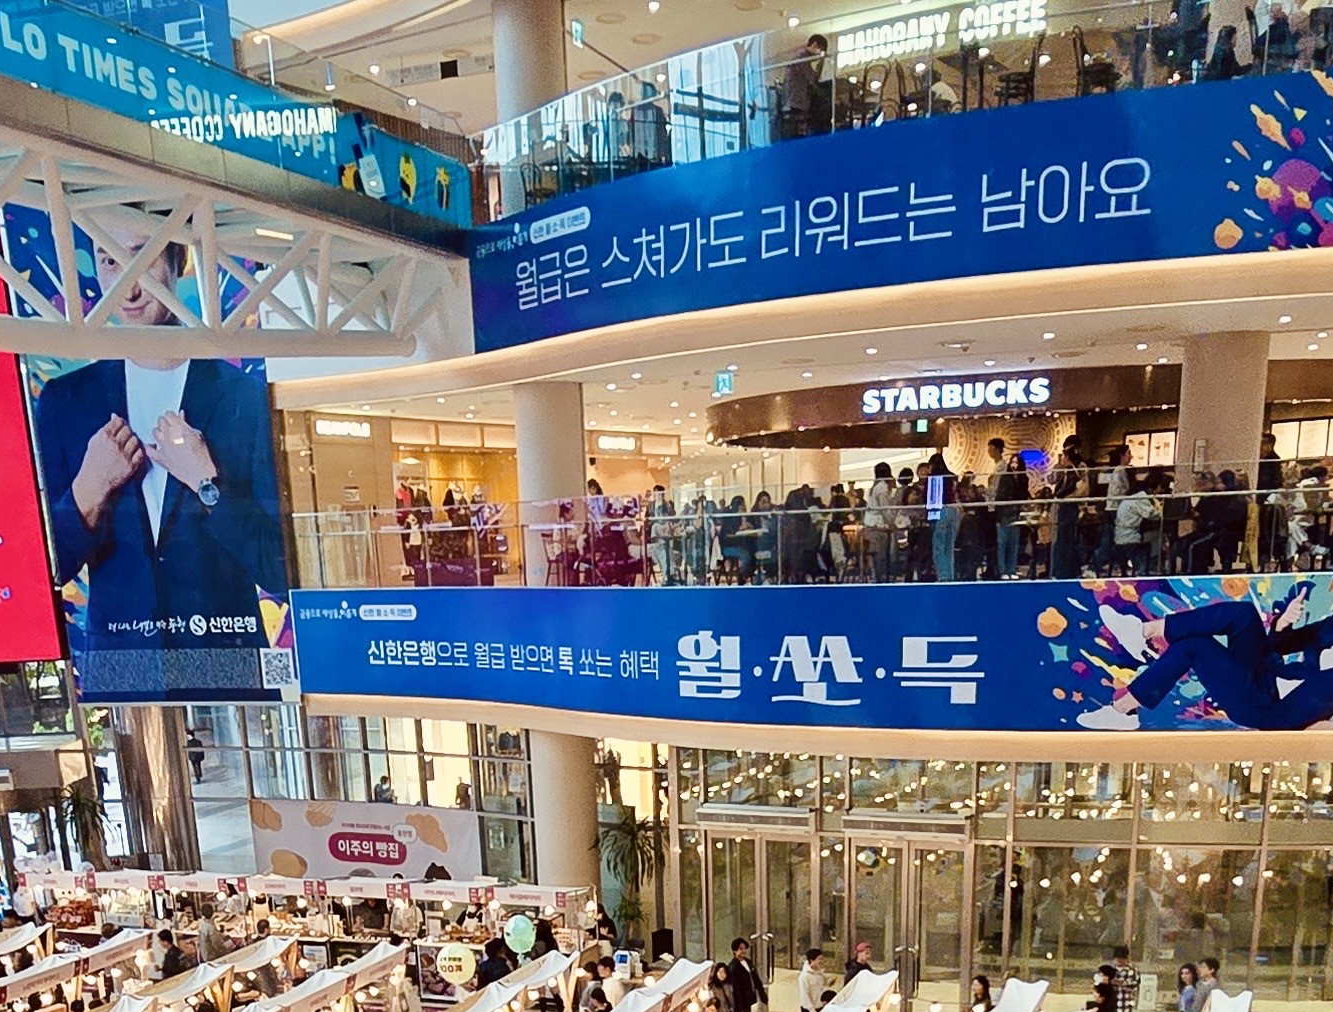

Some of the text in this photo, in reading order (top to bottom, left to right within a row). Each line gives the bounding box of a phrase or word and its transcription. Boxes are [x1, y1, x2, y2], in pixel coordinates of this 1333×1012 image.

[57, 33, 157, 100] TIMES
[515, 155, 1152, 311] 월급은 스쳐가도 리워드는 남아요
[862, 377, 1050, 414] STARBUCKS
[209, 615, 258, 634] 신한은행
[367, 638, 469, 668] 신한은행으로
[473, 642, 506, 670] 월급
[509, 644, 556, 673] 받으면
[558, 646, 574, 675] 톡
[579, 649, 613, 678] 쏘는
[619, 649, 660, 682] 혜택
[337, 839, 400, 860] 이주의 빵집
